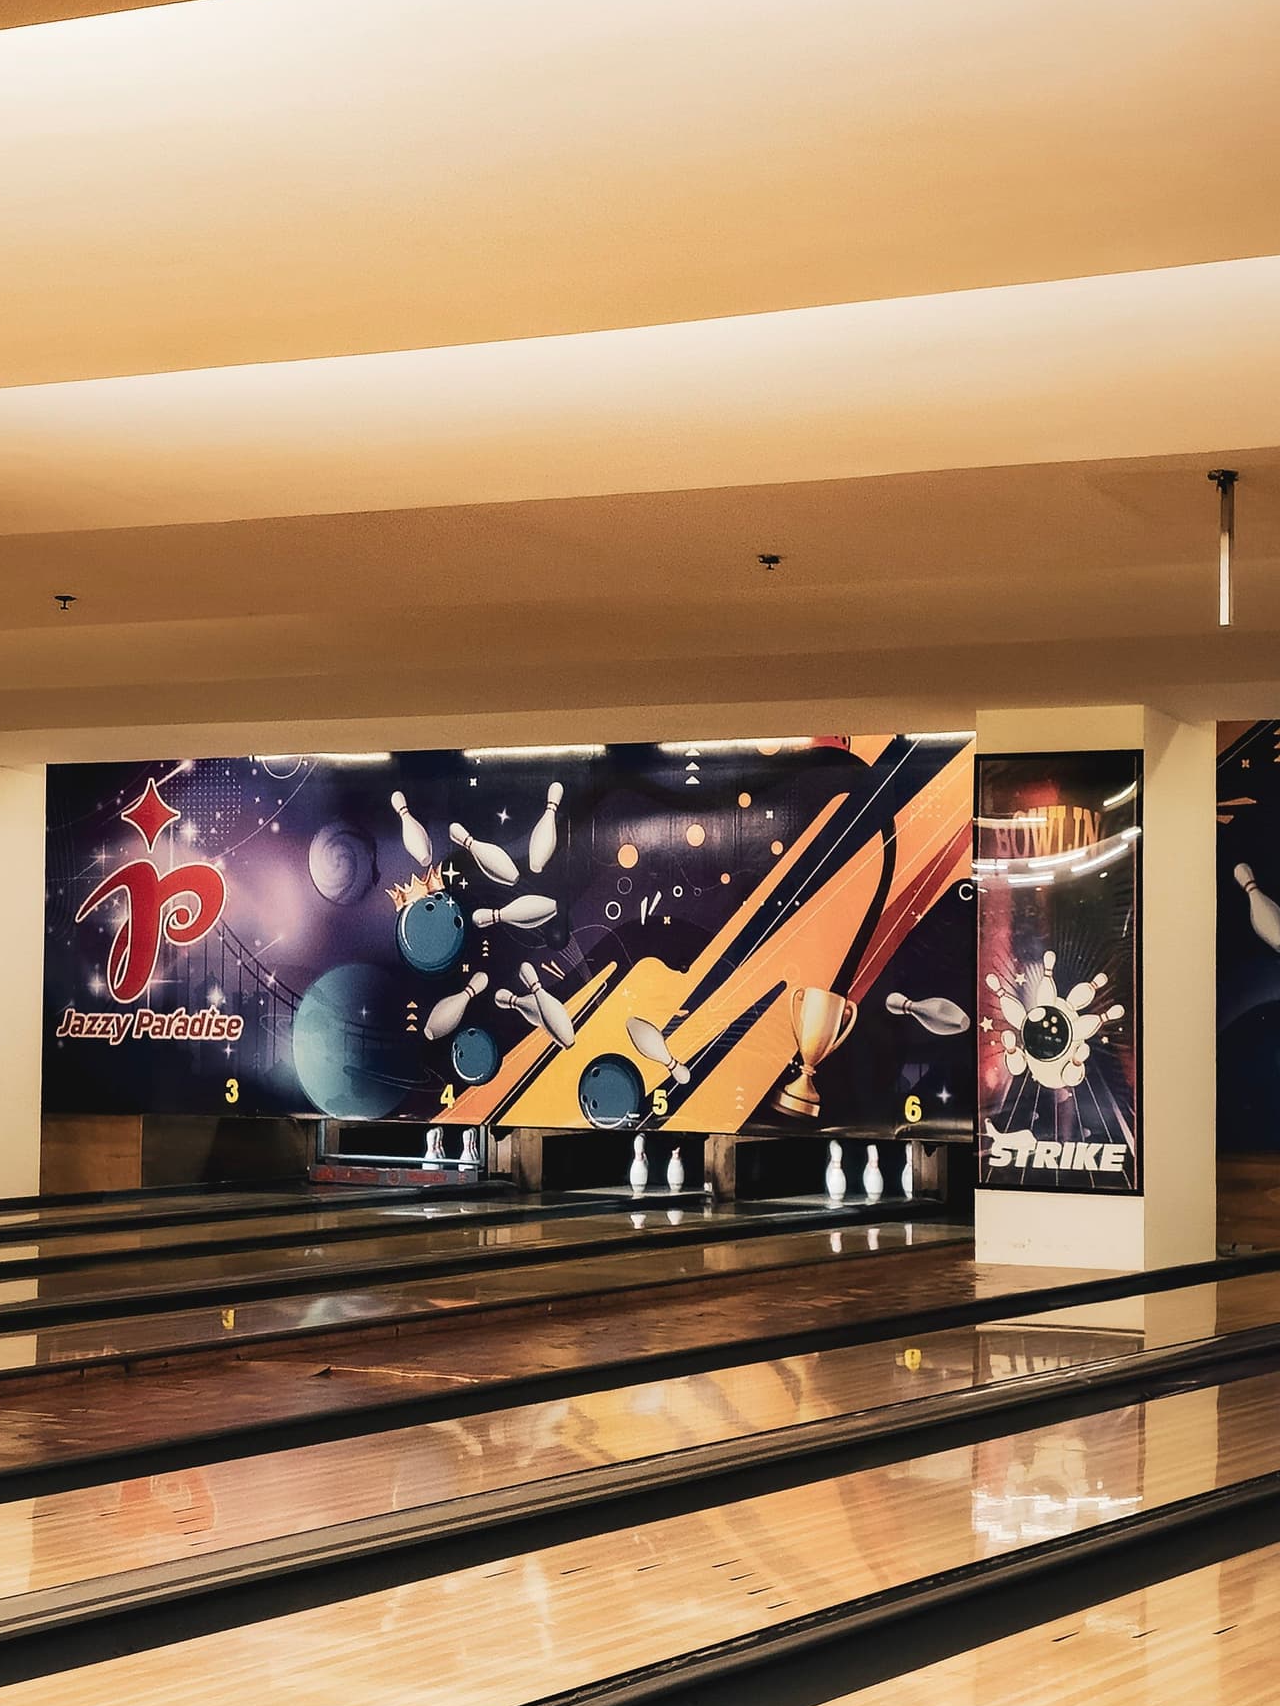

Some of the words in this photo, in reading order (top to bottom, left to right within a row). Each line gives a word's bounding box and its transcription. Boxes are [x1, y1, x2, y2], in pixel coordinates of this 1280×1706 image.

[56, 1009, 131, 1045] Jazzy
[132, 1005, 244, 1041] Paradise
[225, 1078, 239, 1104] 3
[439, 1084, 455, 1110] 4
[651, 1089, 668, 1116] 5
[904, 1094, 922, 1123] 6
[987, 1140, 1128, 1172] STRIKE
